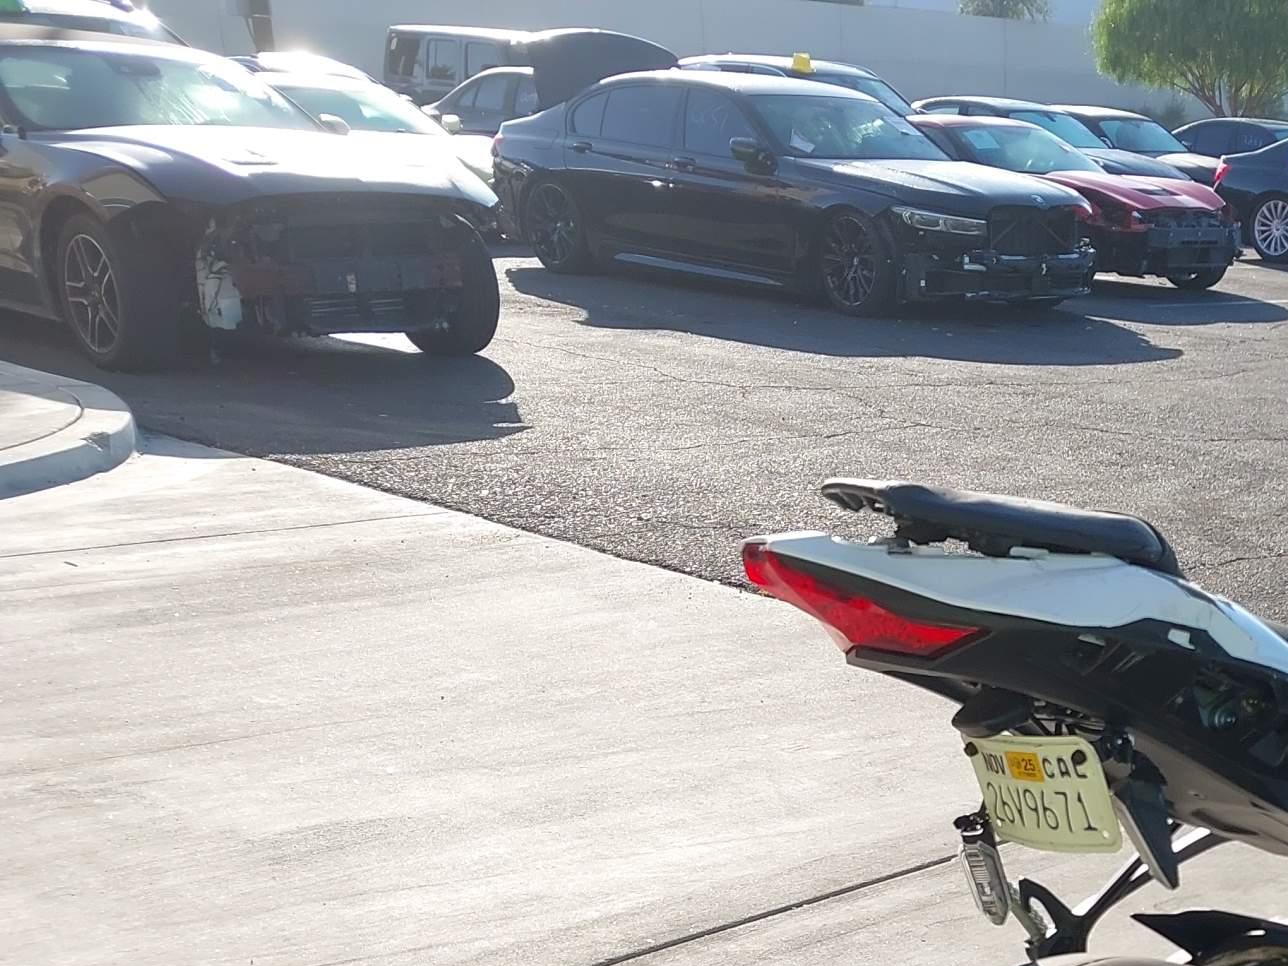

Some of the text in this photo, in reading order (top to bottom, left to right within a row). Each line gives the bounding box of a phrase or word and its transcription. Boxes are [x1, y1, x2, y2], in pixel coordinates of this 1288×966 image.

[981, 751, 1006, 776] NOV
[1022, 758, 1036, 772] 25
[987, 782, 1098, 833] 26V9671
